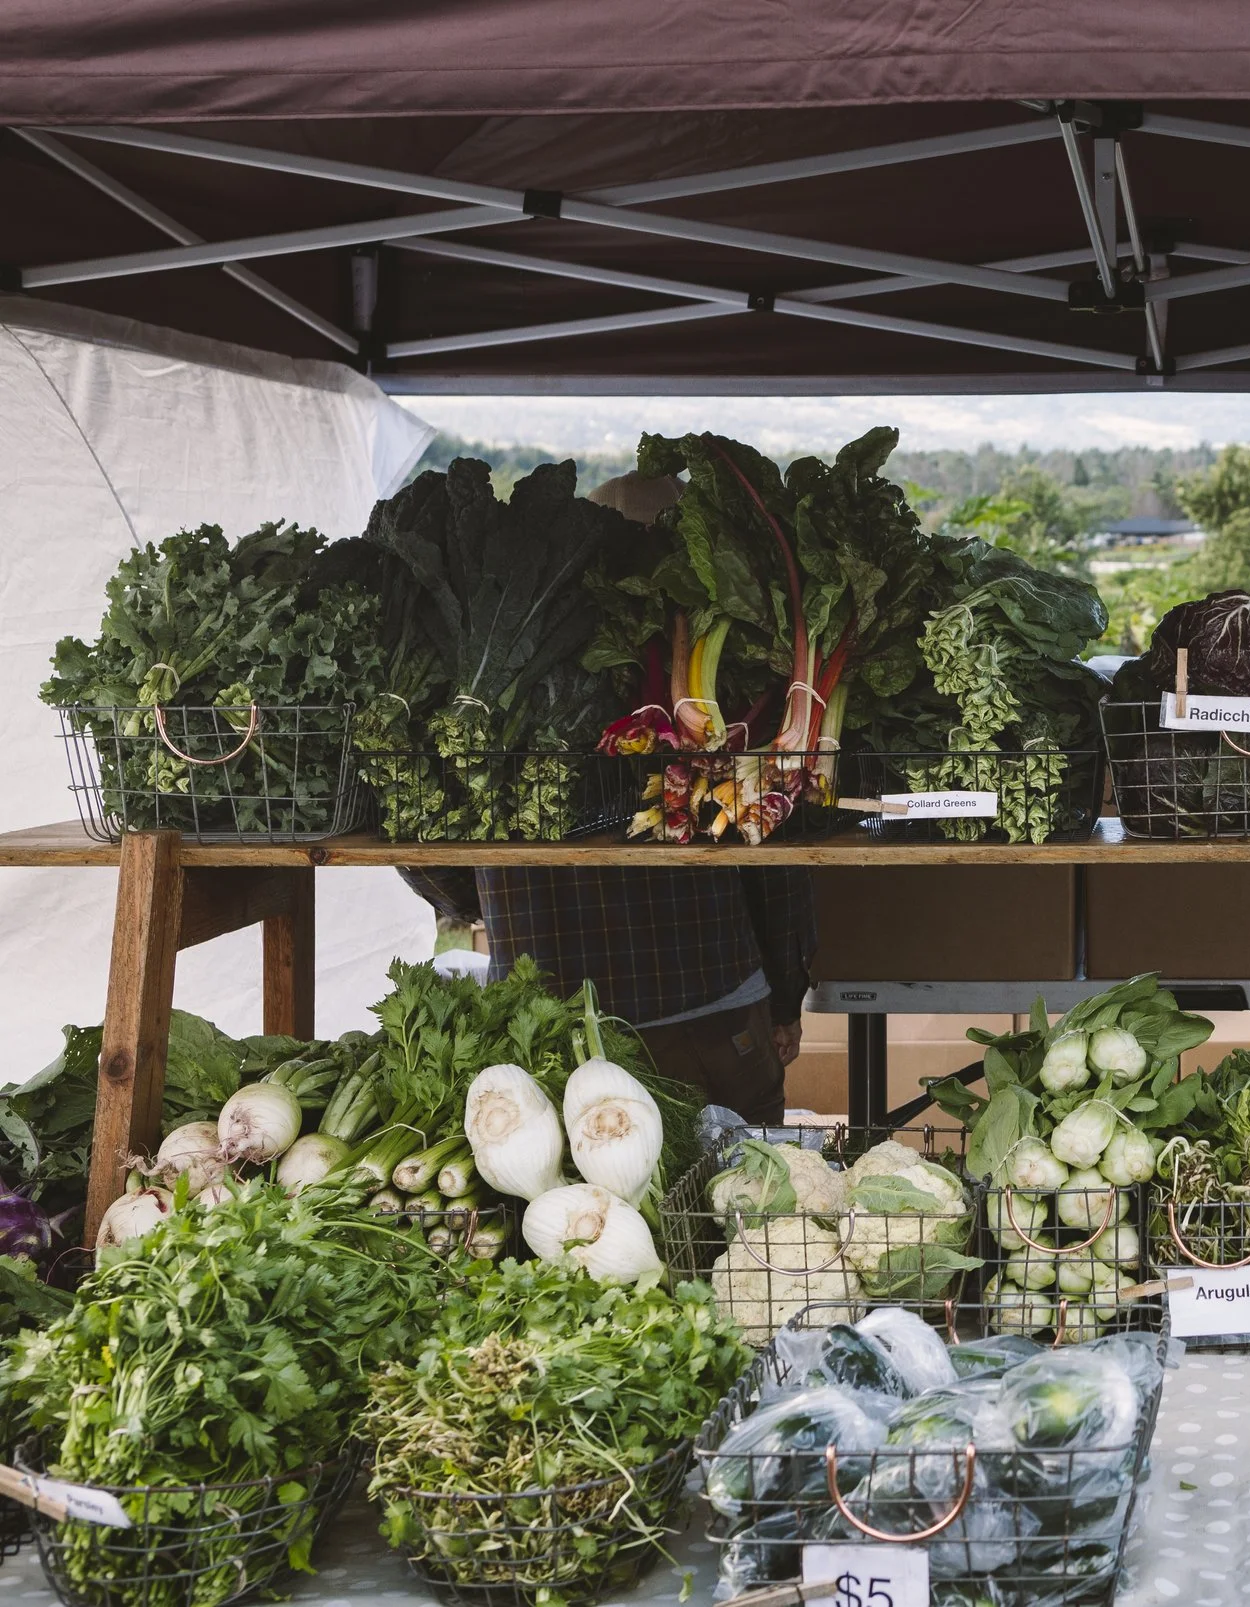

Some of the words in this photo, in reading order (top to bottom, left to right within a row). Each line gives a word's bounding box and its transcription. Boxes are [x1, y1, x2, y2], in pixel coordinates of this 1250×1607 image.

[907, 800, 941, 808] Collard
[943, 799, 977, 808] Greens
[835, 1571, 893, 1607] $5
